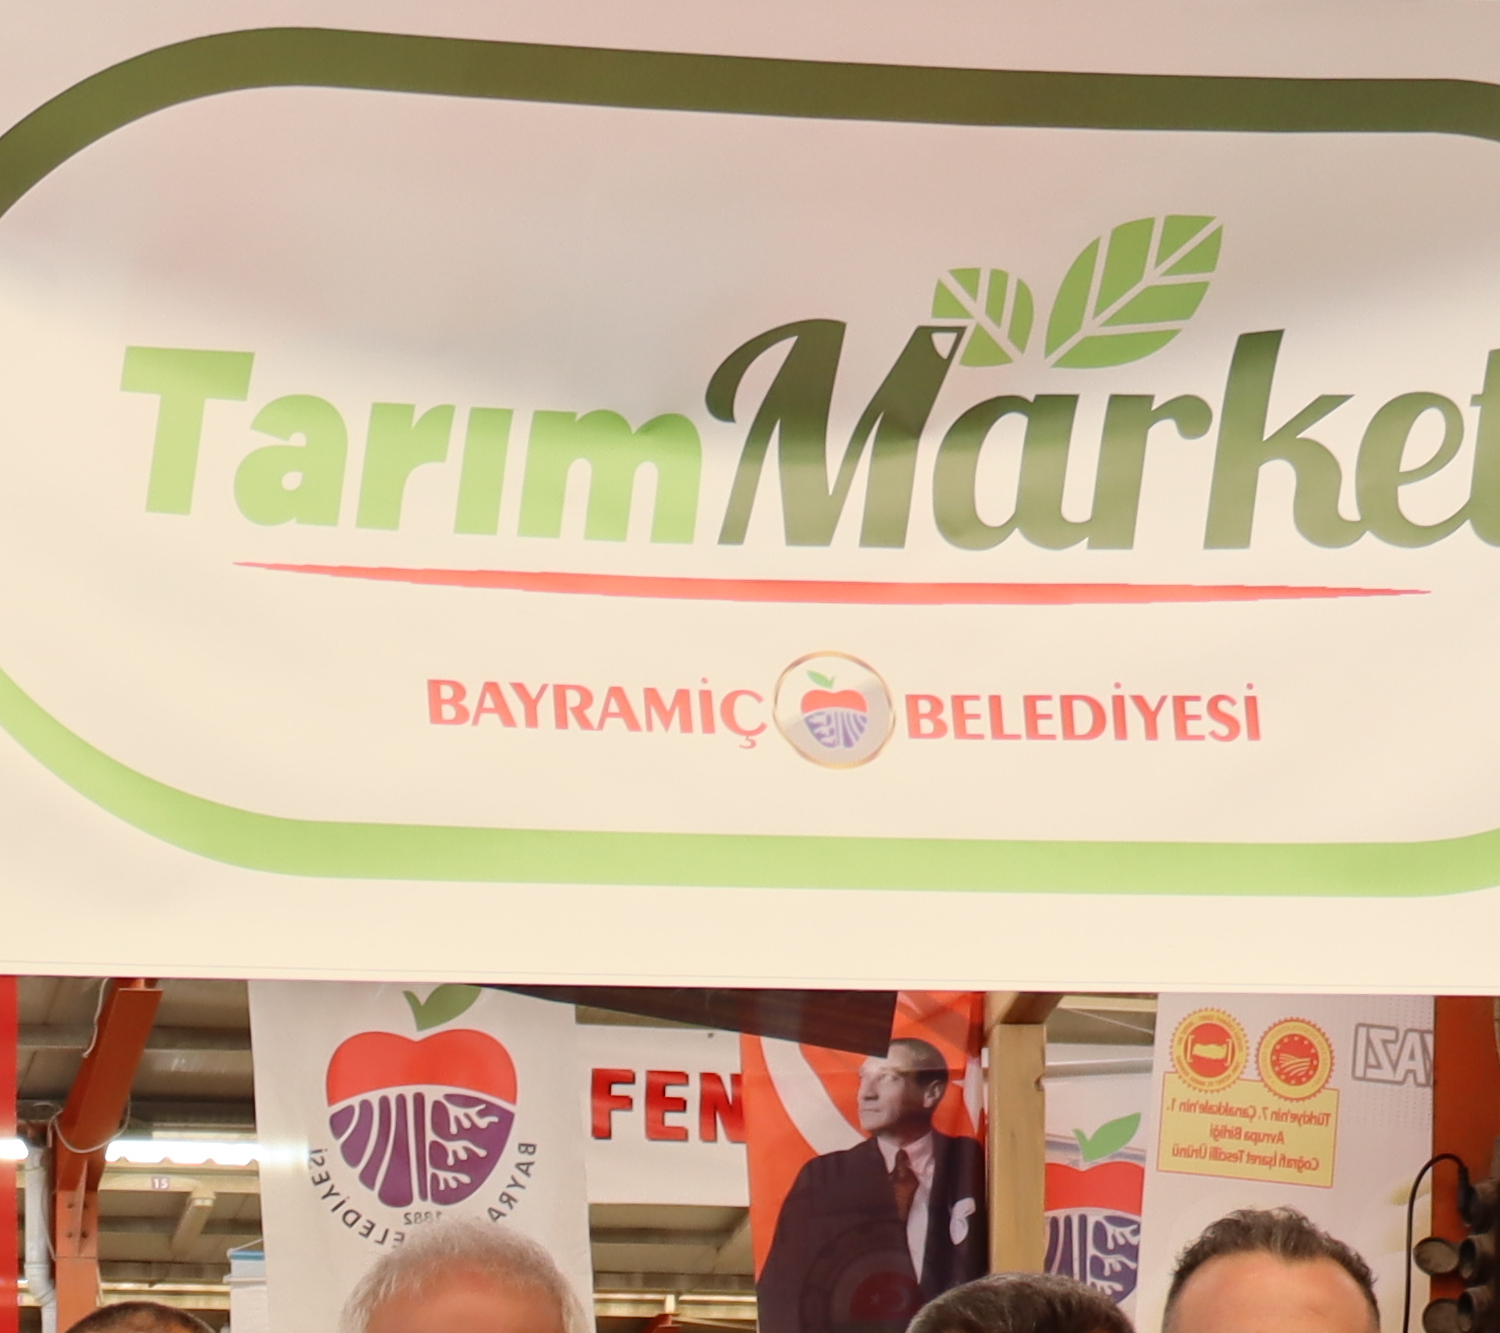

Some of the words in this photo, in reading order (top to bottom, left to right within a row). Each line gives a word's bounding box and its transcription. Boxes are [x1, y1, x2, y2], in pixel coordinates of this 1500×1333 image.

[120, 345, 704, 546] Tarım
[425, 676, 769, 750] BAYRAMİÇ
[905, 681, 1263, 743] BELEDİYESİ
